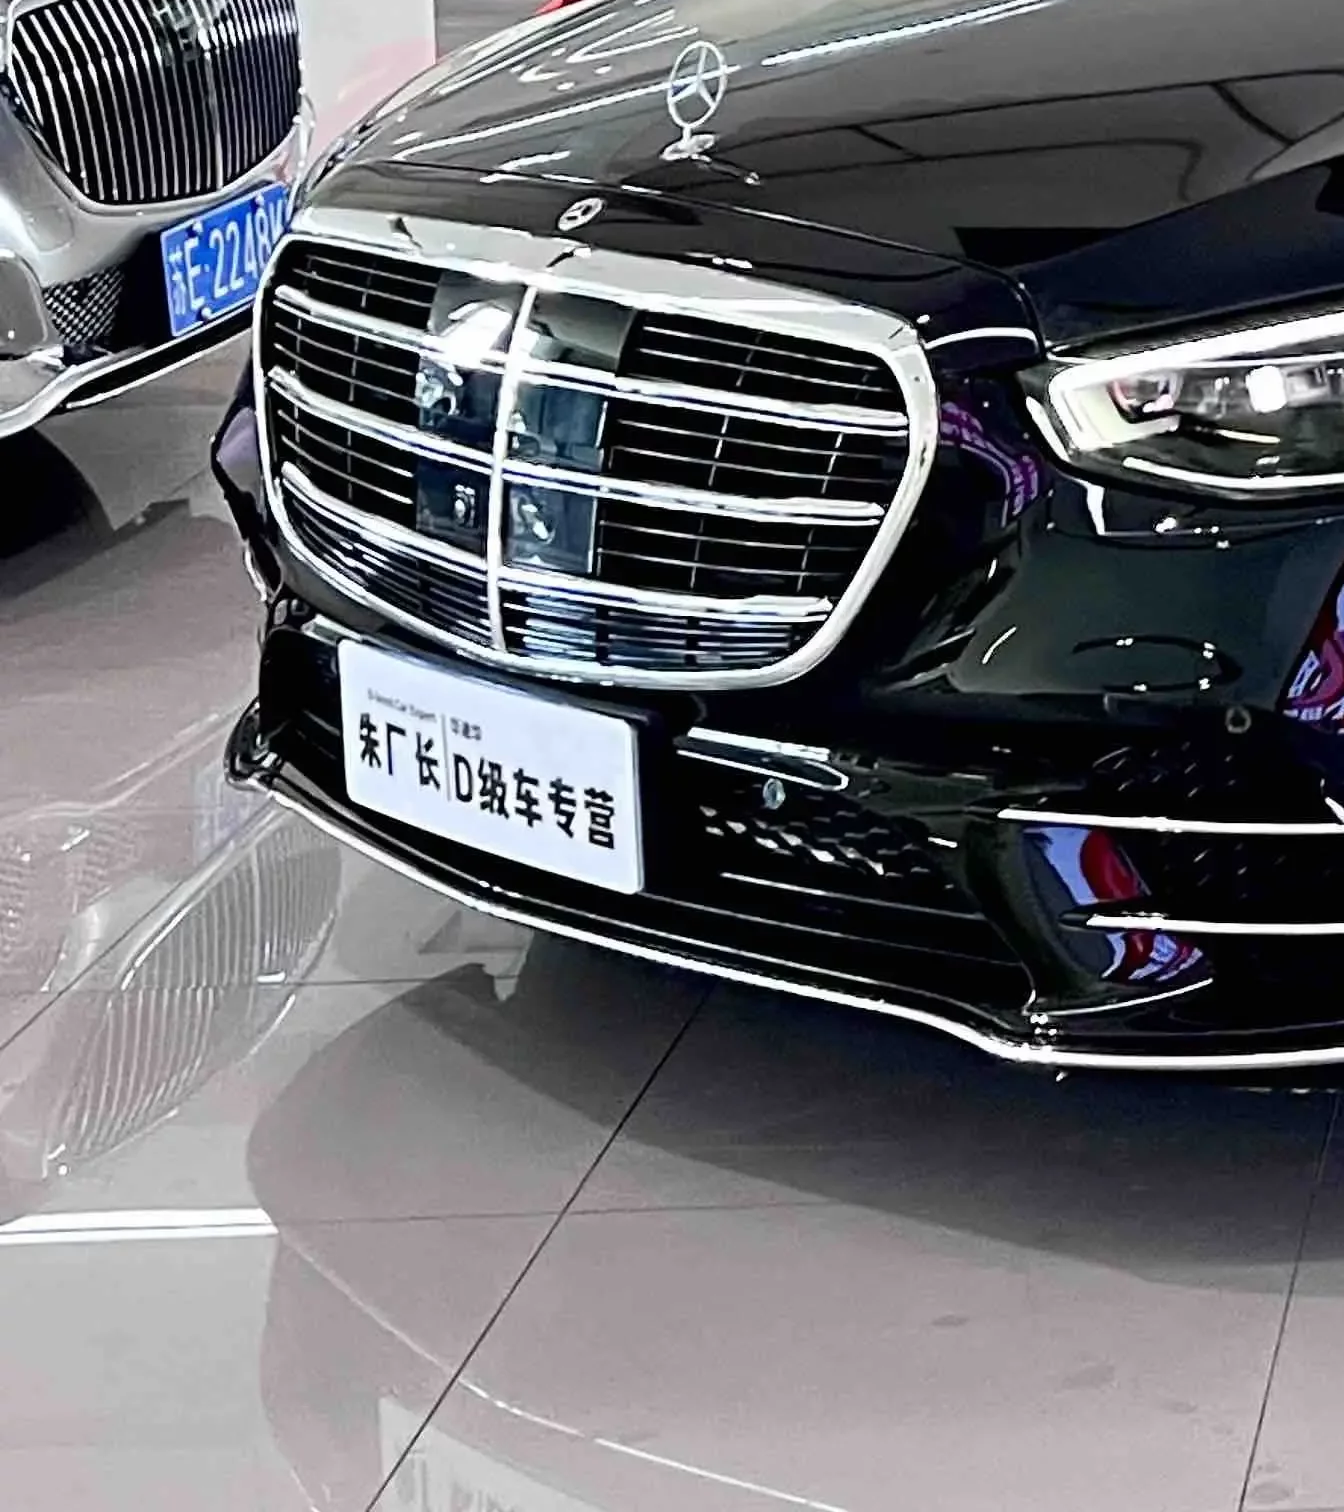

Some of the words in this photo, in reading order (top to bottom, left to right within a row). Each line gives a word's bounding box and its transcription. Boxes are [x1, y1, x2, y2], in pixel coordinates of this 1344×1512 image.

[359, 712, 440, 790] 朱厂长
[453, 752, 615, 850] D级车专营
